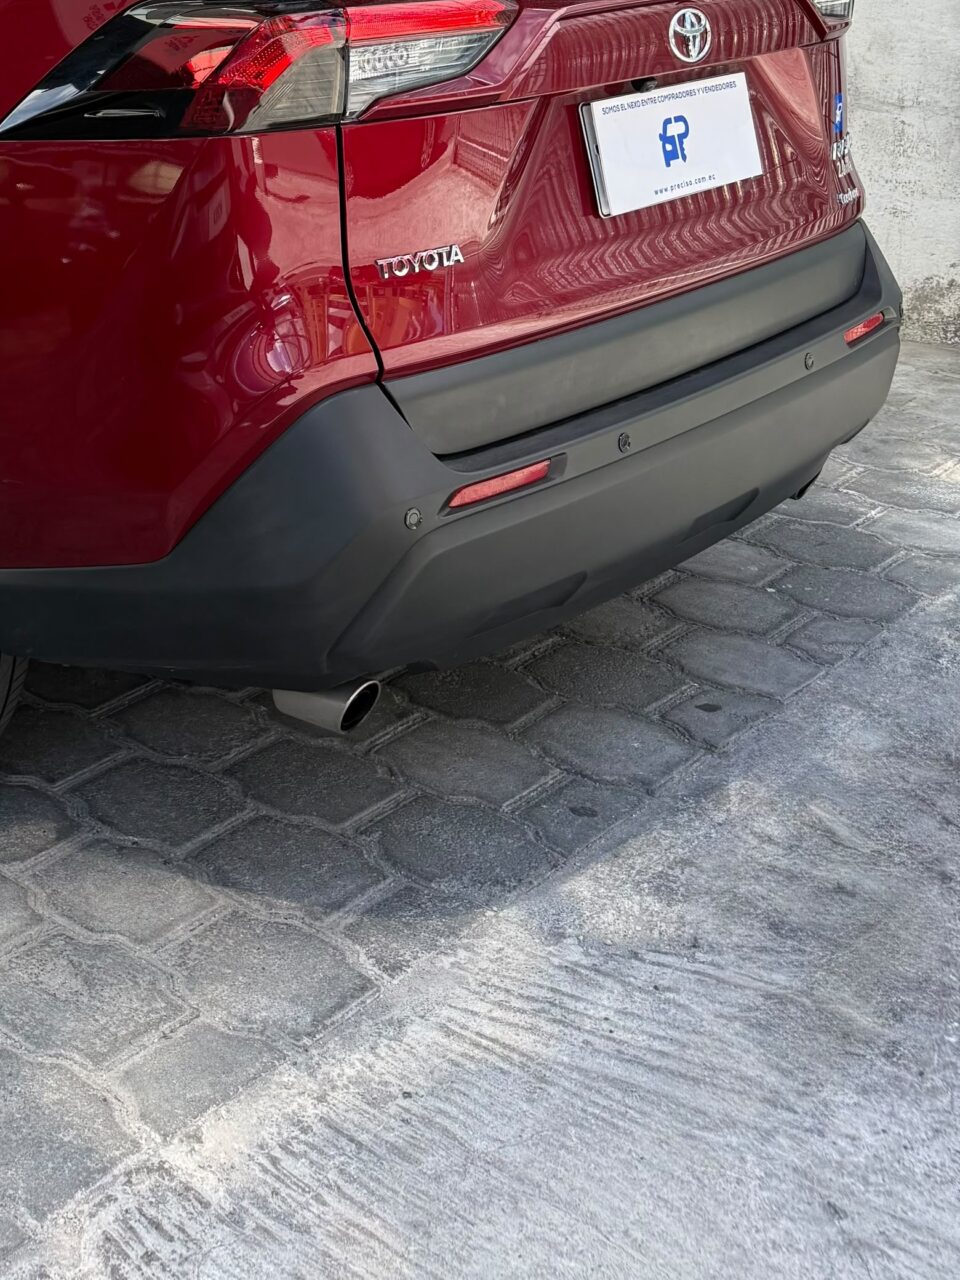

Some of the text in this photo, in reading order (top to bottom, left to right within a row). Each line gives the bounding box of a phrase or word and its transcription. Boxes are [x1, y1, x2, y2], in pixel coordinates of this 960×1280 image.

[601, 105, 621, 115] SOMOS
[621, 104, 628, 112] EL
[627, 100, 641, 110] NEXO
[641, 96, 657, 107] ENTRE
[657, 89, 697, 104] COMPRADORES
[701, 80, 737, 95] VENDEDORES
[654, 174, 716, 195] www.preciso.com.ec
[376, 244, 465, 279] TOYOTA
